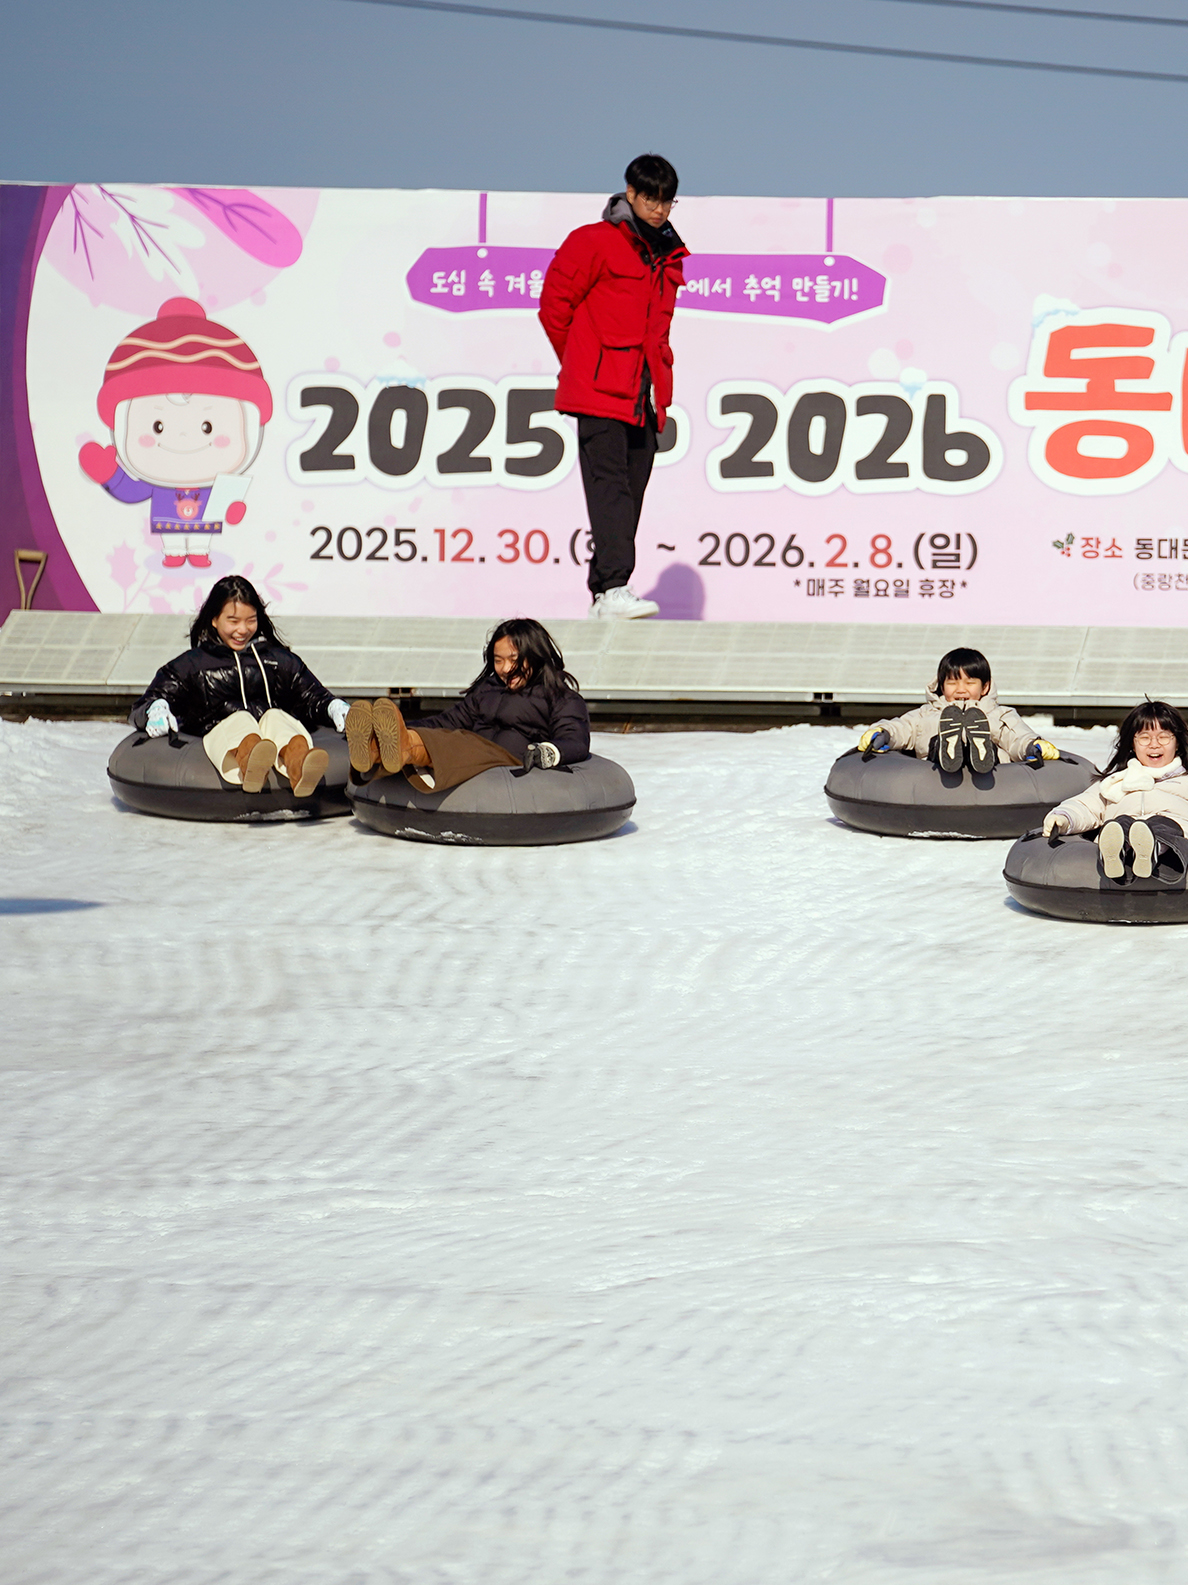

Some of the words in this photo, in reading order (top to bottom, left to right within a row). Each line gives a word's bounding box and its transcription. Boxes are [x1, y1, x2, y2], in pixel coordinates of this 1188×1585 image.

[430, 269, 466, 296] 도심
[478, 269, 496, 298] 속
[504, 269, 545, 299] 겨울
[676, 276, 732, 299] 에서
[743, 274, 781, 302] 추억
[792, 274, 859, 303] 만들기!
[300, 384, 565, 477] 2025
[719, 391, 991, 482] 2026
[1081, 537, 1123, 559] 장소
[853, 578, 910, 598] 월요일
